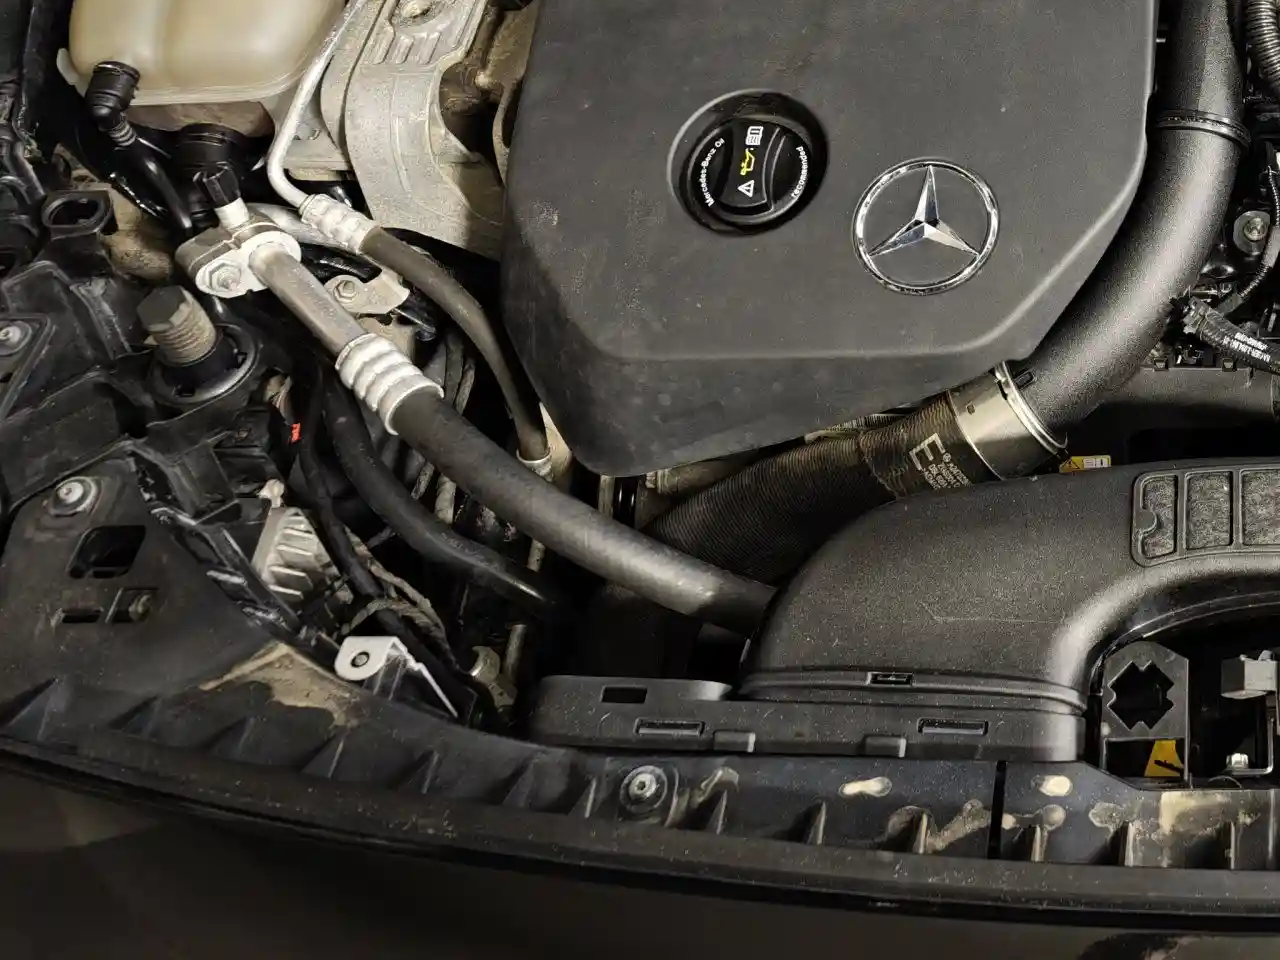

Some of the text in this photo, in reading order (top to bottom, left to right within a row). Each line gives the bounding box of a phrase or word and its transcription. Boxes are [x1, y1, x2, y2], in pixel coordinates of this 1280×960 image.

[700, 137, 726, 207] Mercedes-Benz Oil
[791, 145, 810, 198] recommended
